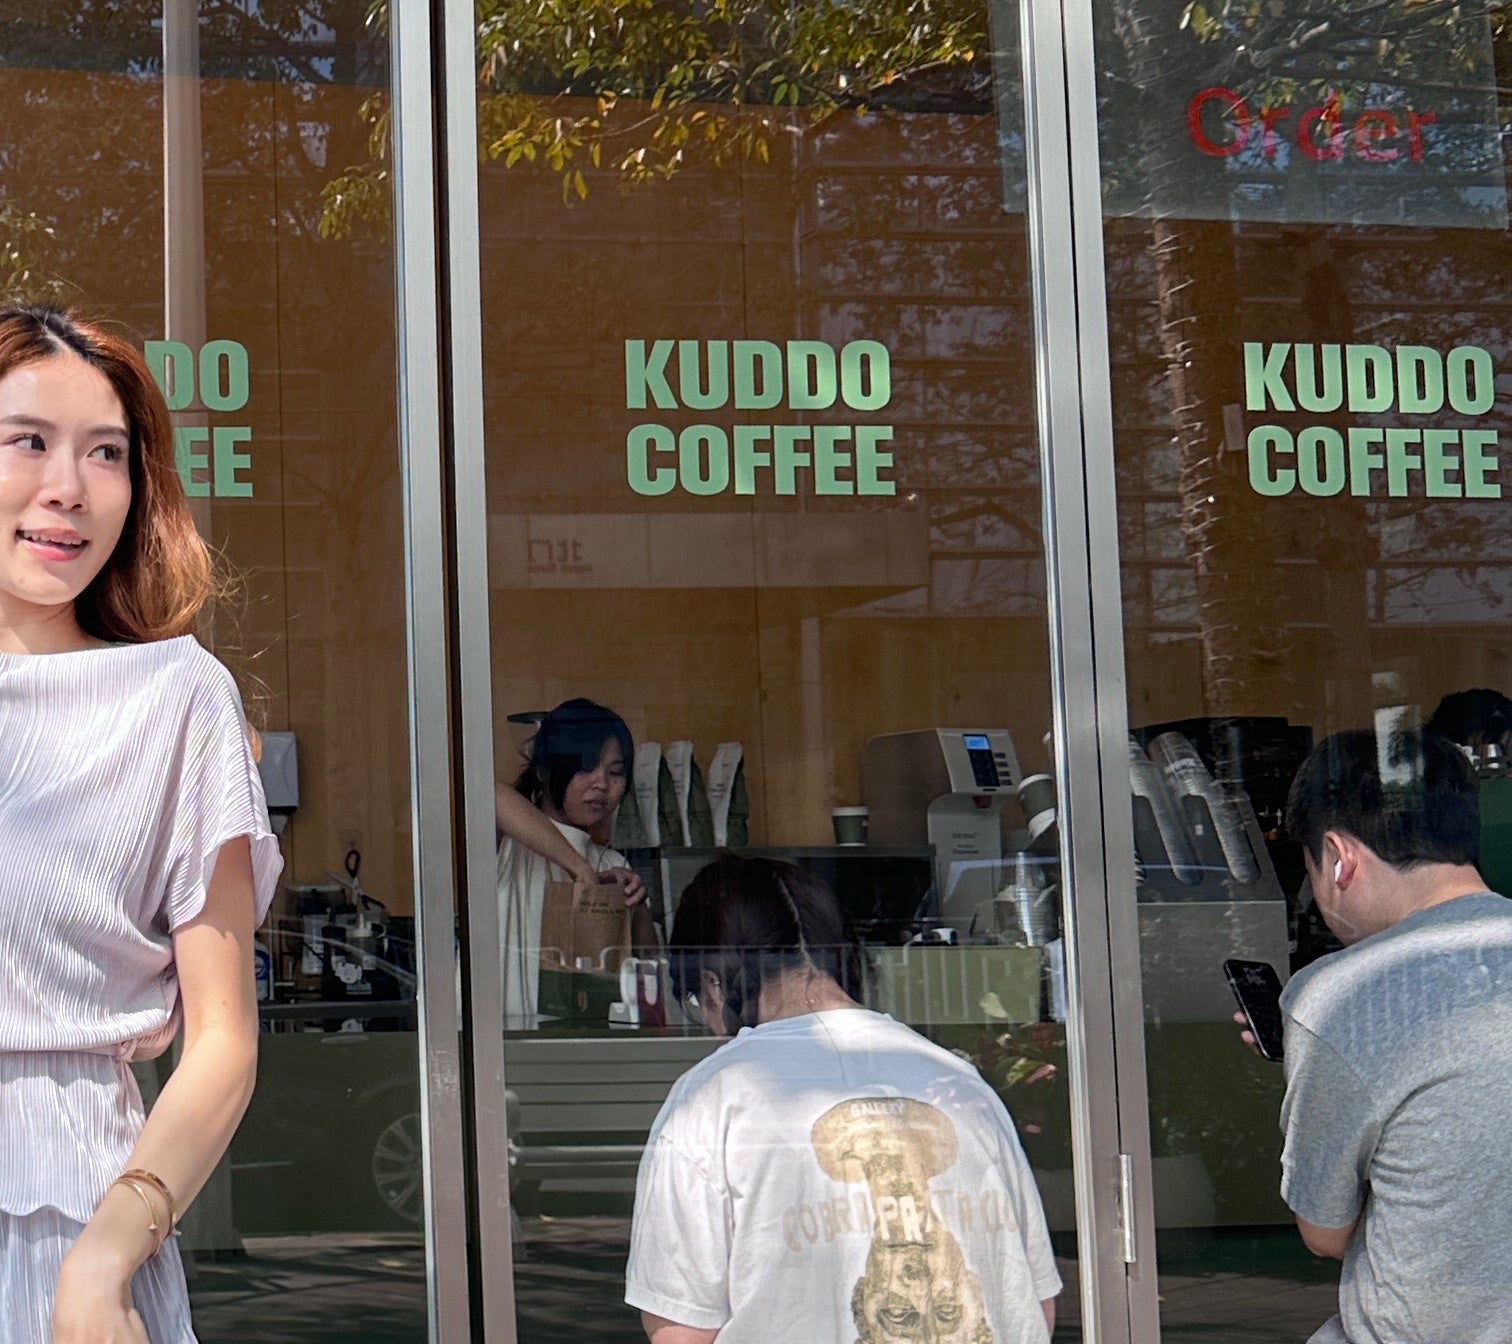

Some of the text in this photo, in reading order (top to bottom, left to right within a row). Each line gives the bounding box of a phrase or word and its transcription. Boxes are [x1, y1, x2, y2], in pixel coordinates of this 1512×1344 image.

[1187, 87, 1437, 162] Order
[624, 339, 891, 411] KUDDO
[1243, 342, 1495, 415] KUDDO
[626, 424, 896, 496] COFFEE
[1247, 425, 1502, 498] COFFEE
